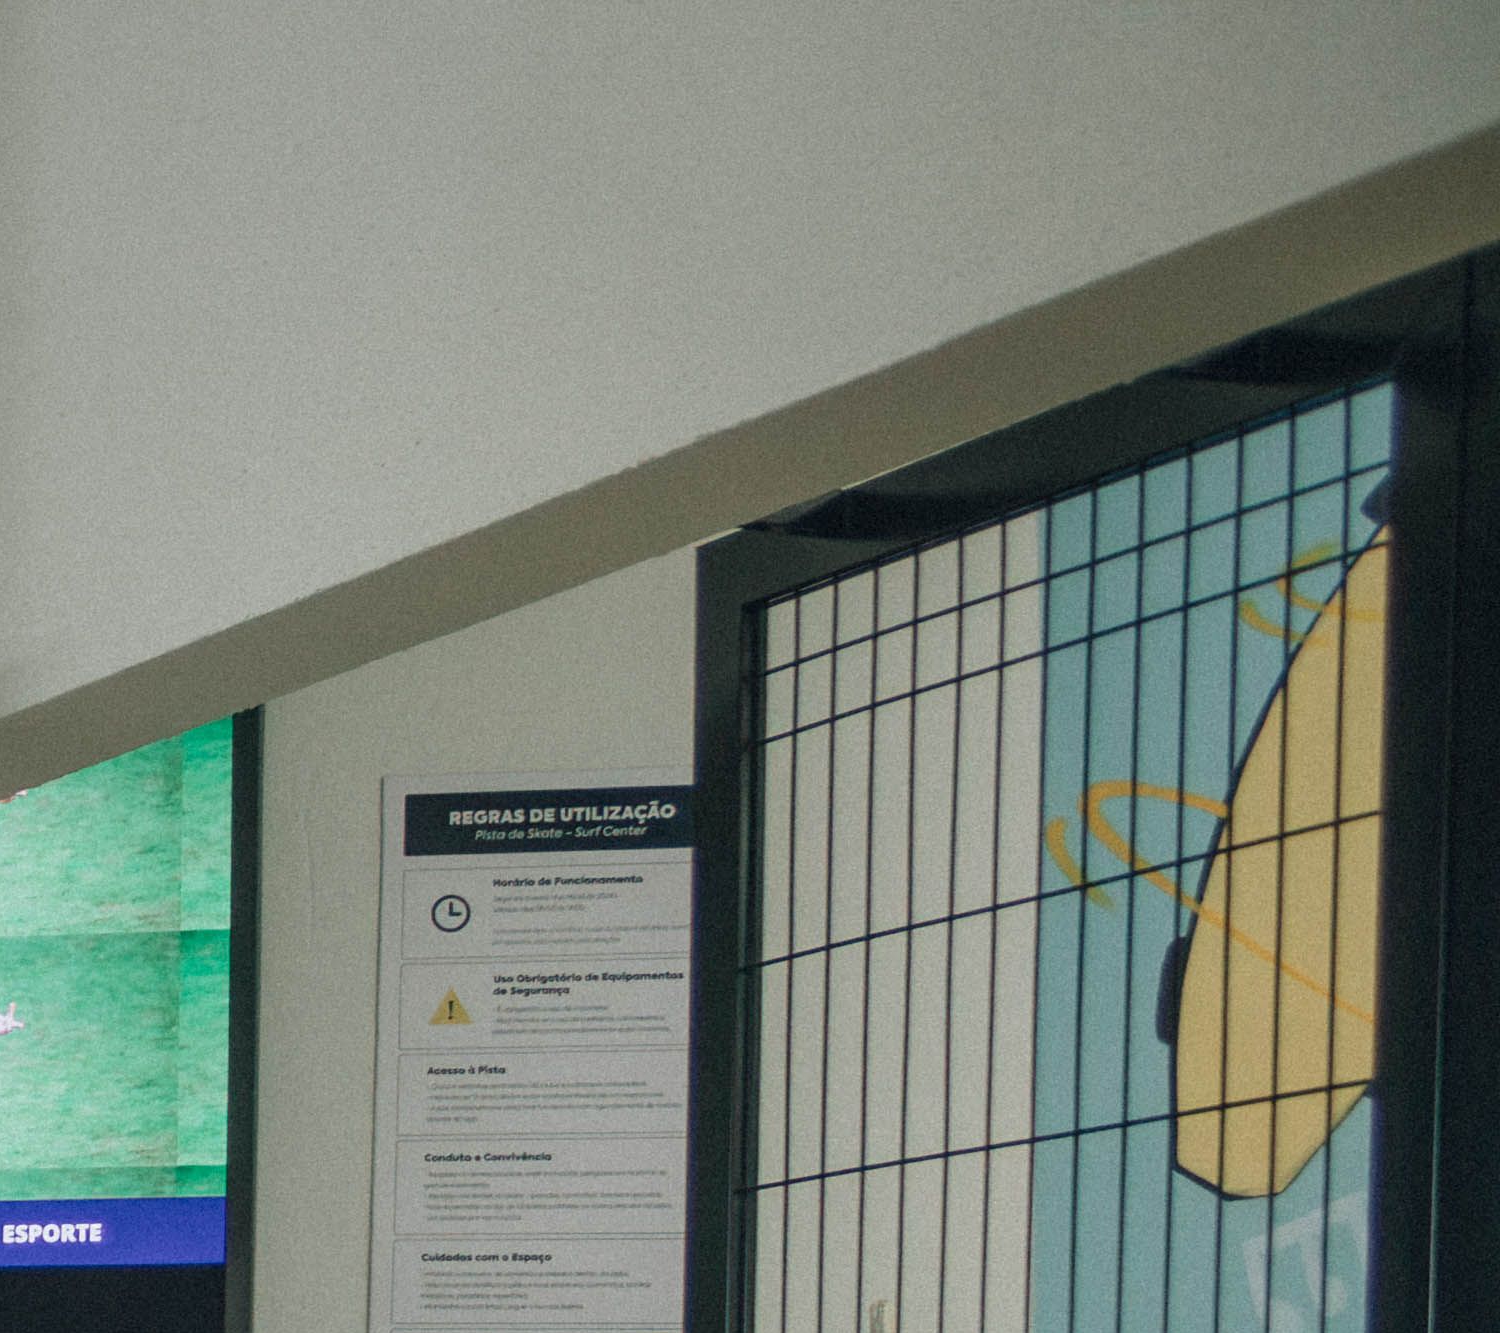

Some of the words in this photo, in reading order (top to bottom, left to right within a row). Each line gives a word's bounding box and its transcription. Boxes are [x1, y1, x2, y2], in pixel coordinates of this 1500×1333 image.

[449, 808, 525, 826] REGRAS
[529, 807, 556, 823] DE
[560, 800, 677, 824] UTILIZAÇÃO
[474, 829, 506, 841] Pista
[508, 828, 525, 840] de
[527, 827, 562, 839] Skate
[575, 825, 601, 838] Surf
[603, 825, 648, 838] Center
[492, 875, 536, 888] Horário
[538, 877, 552, 887] de
[554, 875, 644, 886] Funcionamento
[493, 974, 514, 984] Uso
[516, 972, 582, 986] Obrigatório
[585, 972, 599, 982] de
[601, 970, 684, 984] Equipamentos
[493, 986, 508, 996] de
[510, 985, 570, 998] Segurança
[427, 1065, 466, 1076] Acesso
[478, 1065, 506, 1075] Pista
[424, 1152, 472, 1163] Conduta
[483, 1152, 552, 1163] Convivência
[2, 1222, 102, 1244] ESPORTE
[421, 1252, 472, 1263] Cuidados
[511, 1253, 552, 1265] Espaço
